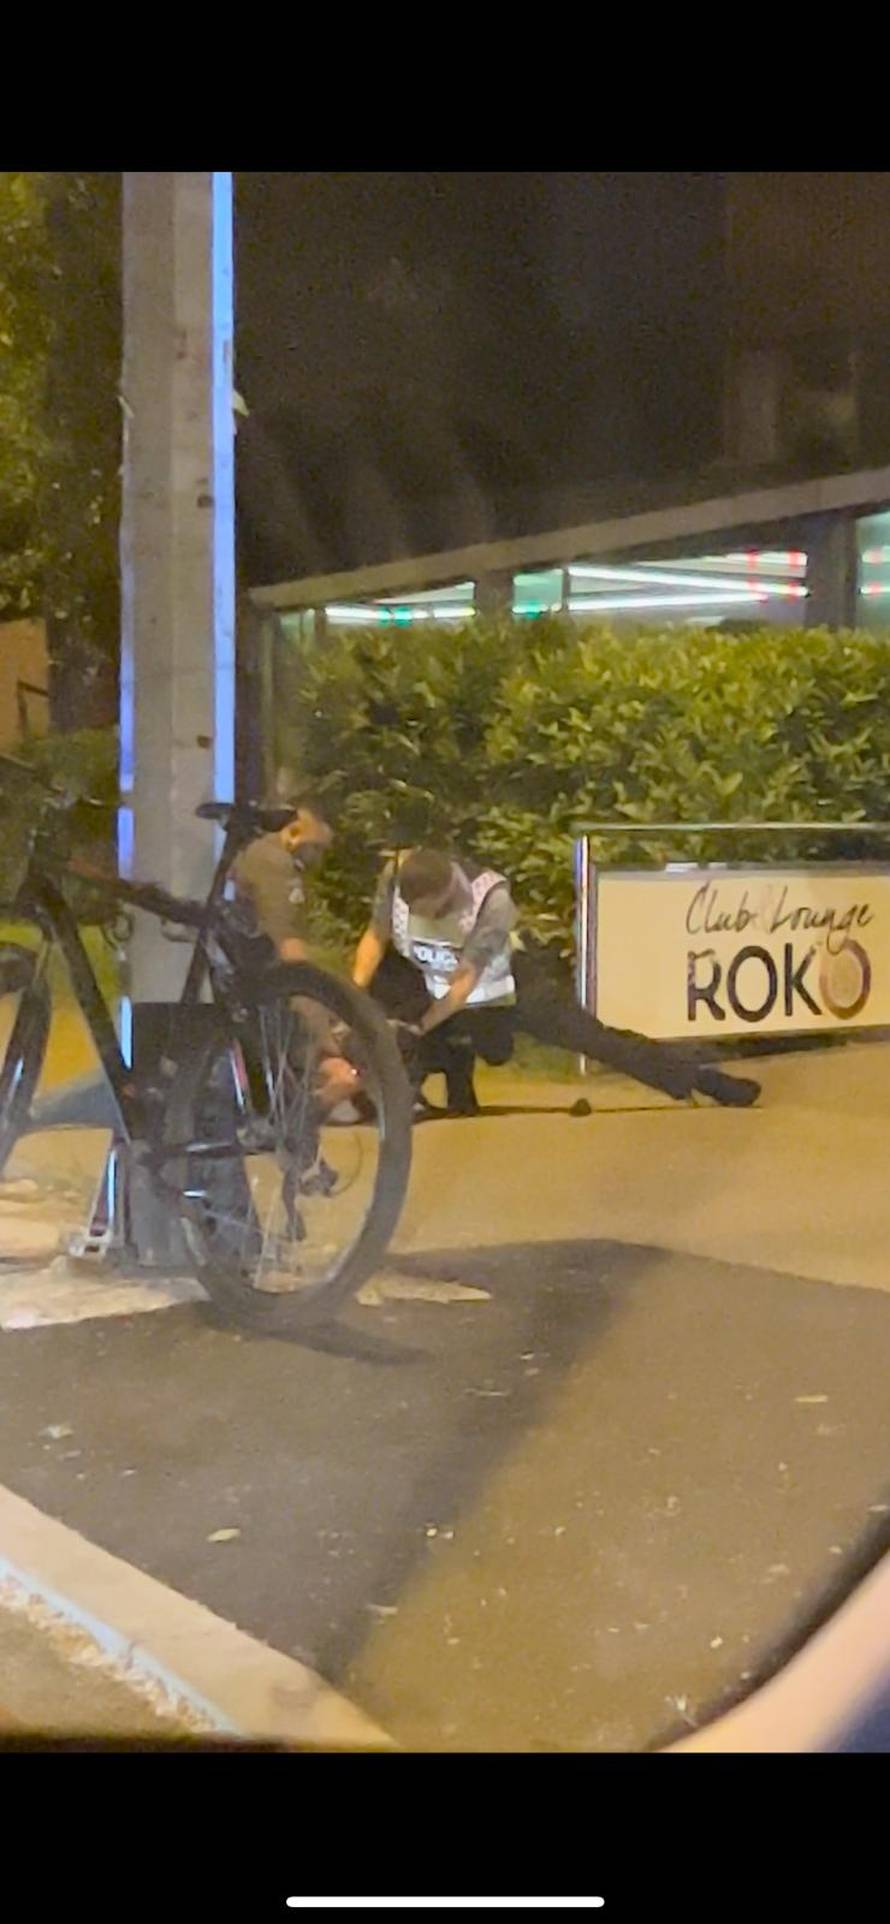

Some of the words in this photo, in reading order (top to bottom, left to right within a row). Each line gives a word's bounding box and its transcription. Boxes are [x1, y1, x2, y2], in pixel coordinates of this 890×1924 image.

[686, 881, 750, 934] Club
[769, 885, 873, 955] Lounge
[686, 938, 872, 1022] ROKO
